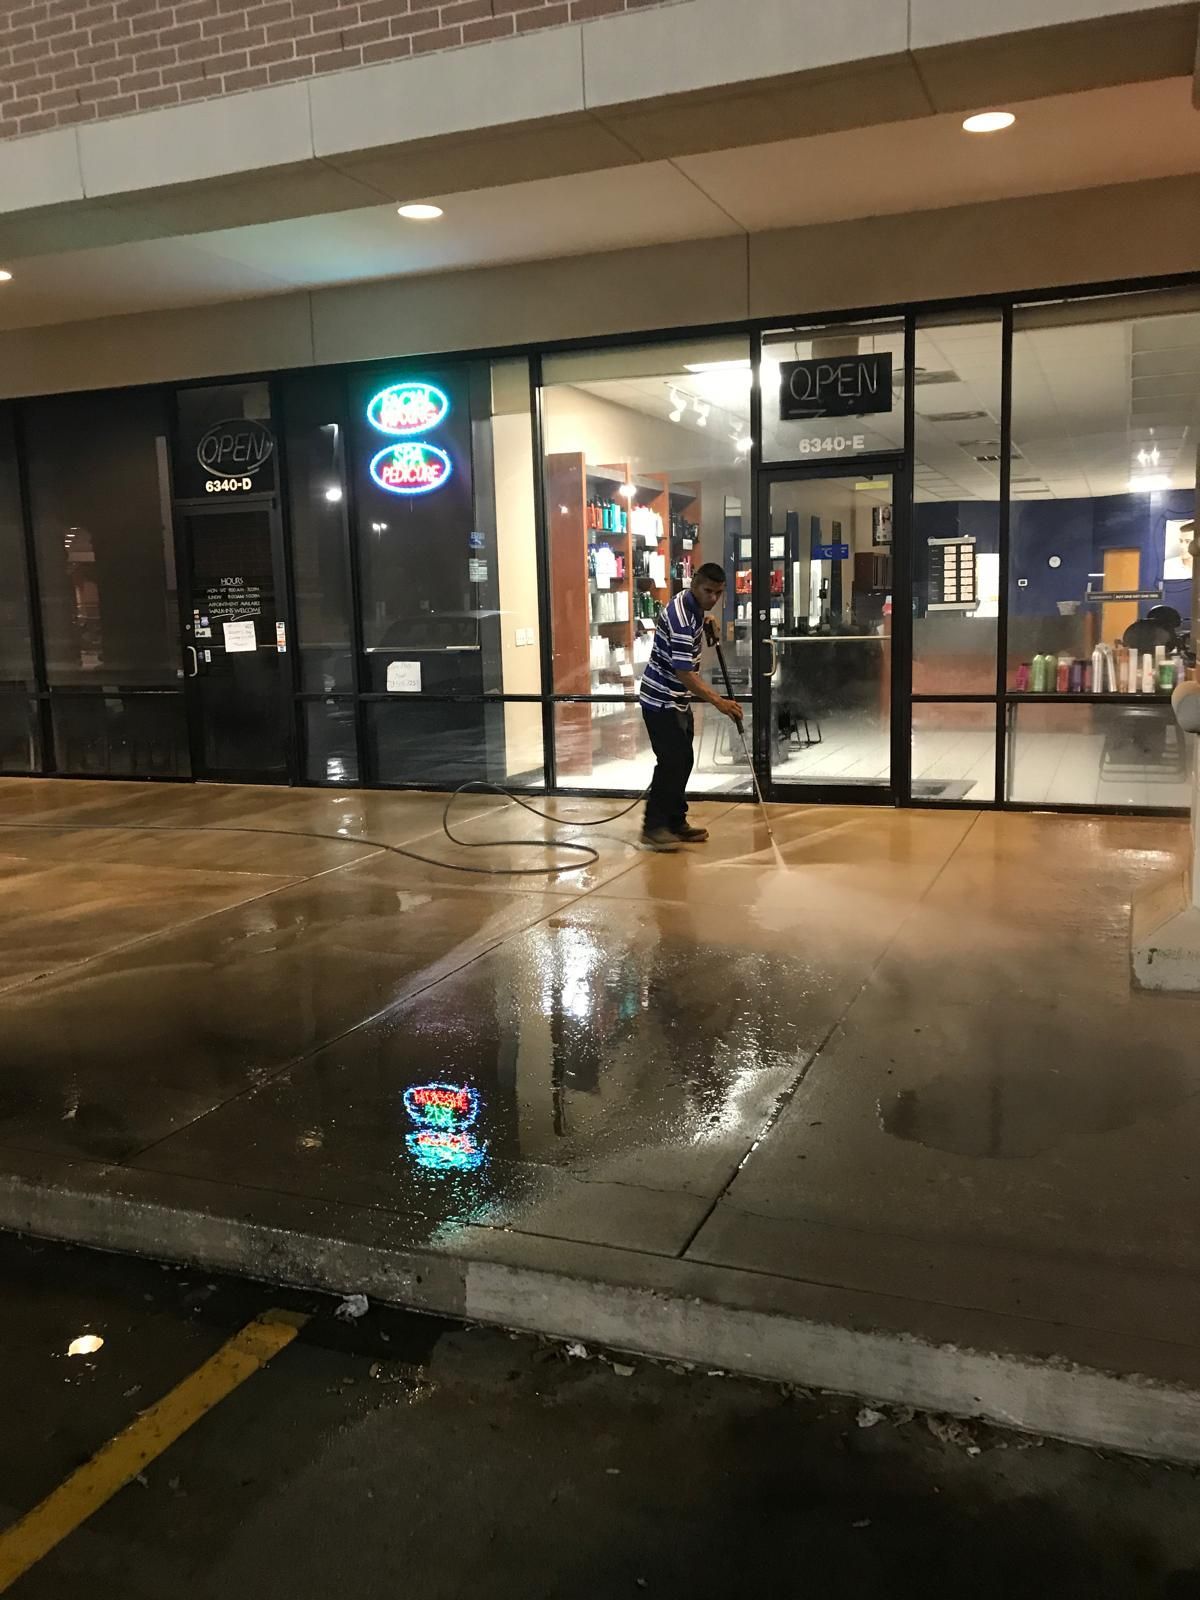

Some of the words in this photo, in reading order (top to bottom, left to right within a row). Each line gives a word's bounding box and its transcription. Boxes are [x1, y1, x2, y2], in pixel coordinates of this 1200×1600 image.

[789, 360, 877, 401] OPEN
[202, 431, 266, 463] OPEN
[799, 435, 865, 454] 6340-E
[382, 461, 441, 483] PEDICURE
[205, 478, 252, 493] 6340-D
[220, 577, 244, 586] HOURS
